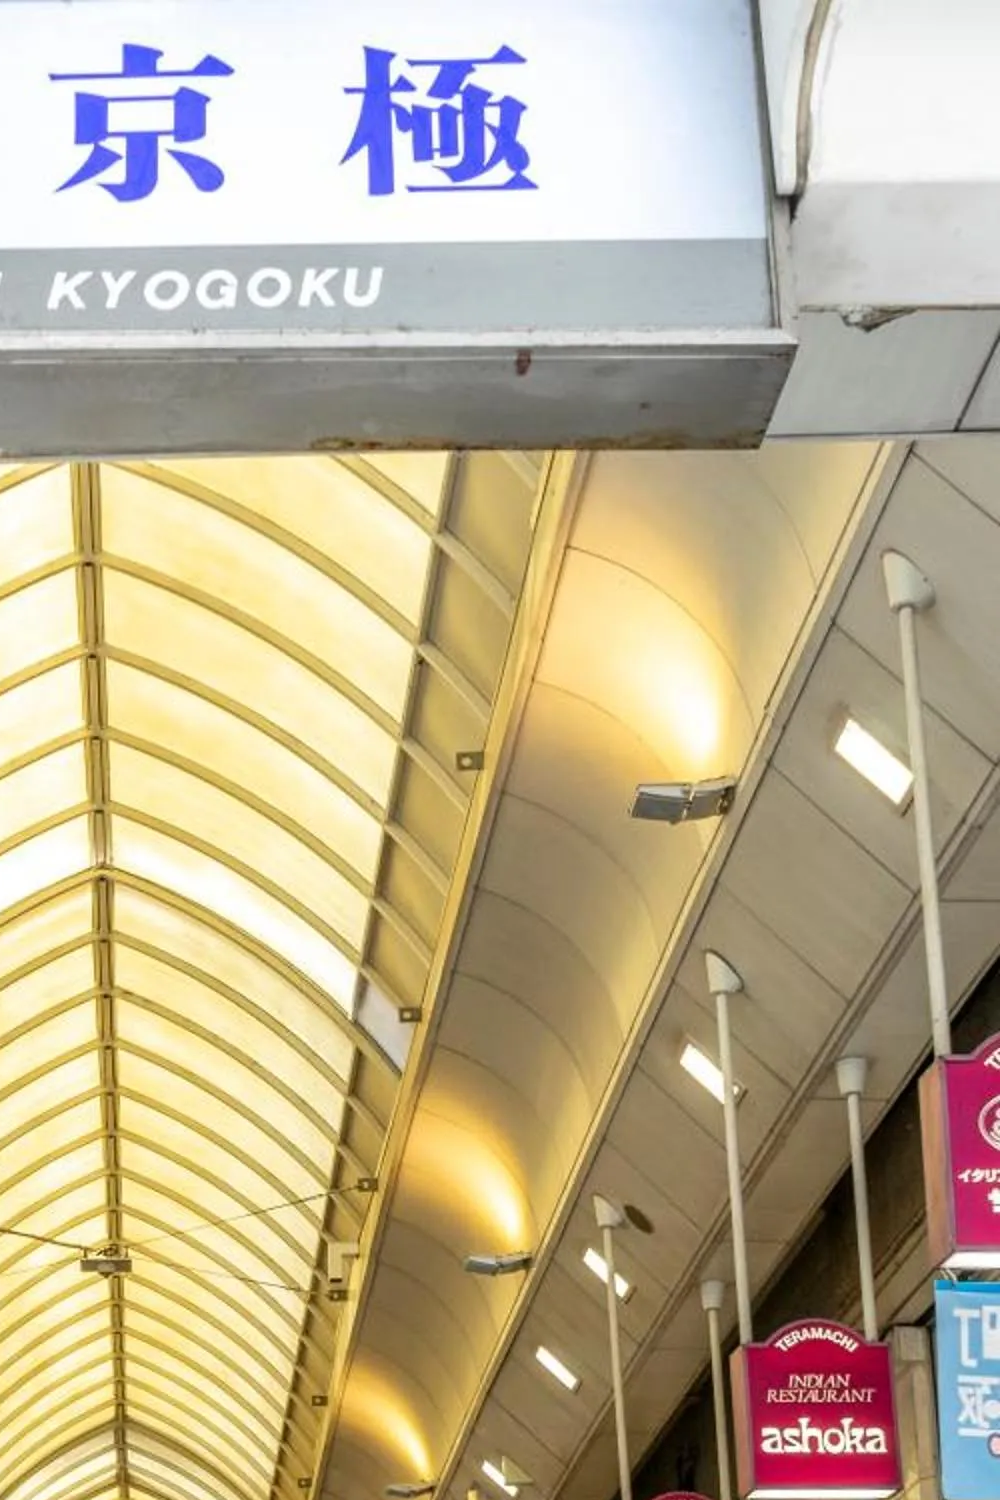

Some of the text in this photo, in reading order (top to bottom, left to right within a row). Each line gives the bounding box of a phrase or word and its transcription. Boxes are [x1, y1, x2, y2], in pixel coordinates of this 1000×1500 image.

[47, 265, 385, 312] KYOGOKU
[774, 1326, 860, 1353] TERAMACHI
[787, 1373, 851, 1388] INDIAN
[766, 1387, 877, 1404] RESTAURANT
[760, 1416, 888, 1455] ashoka
